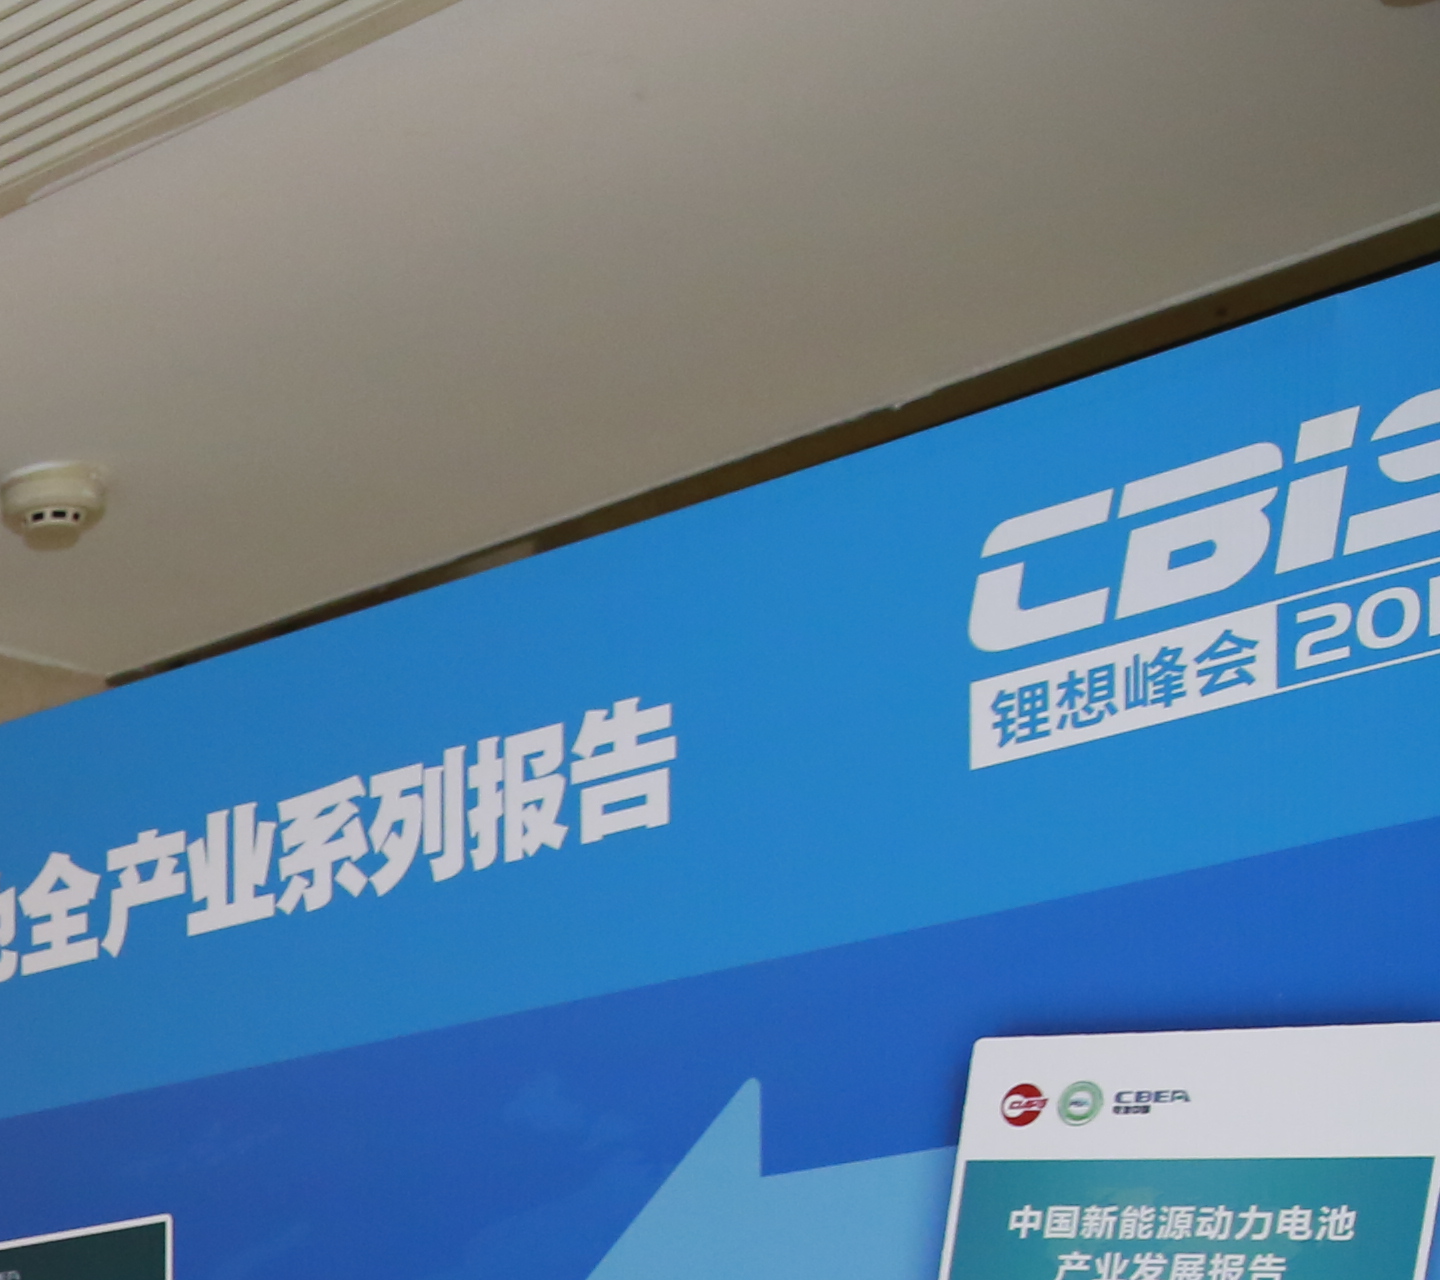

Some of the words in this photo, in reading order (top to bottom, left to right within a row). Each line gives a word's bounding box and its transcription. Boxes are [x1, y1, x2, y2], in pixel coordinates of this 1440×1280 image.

[989, 629, 1260, 749] 锂想峰会
[1114, 1089, 1191, 1103] CBEA
[1008, 1204, 1358, 1242] 中国新能源动力电池
